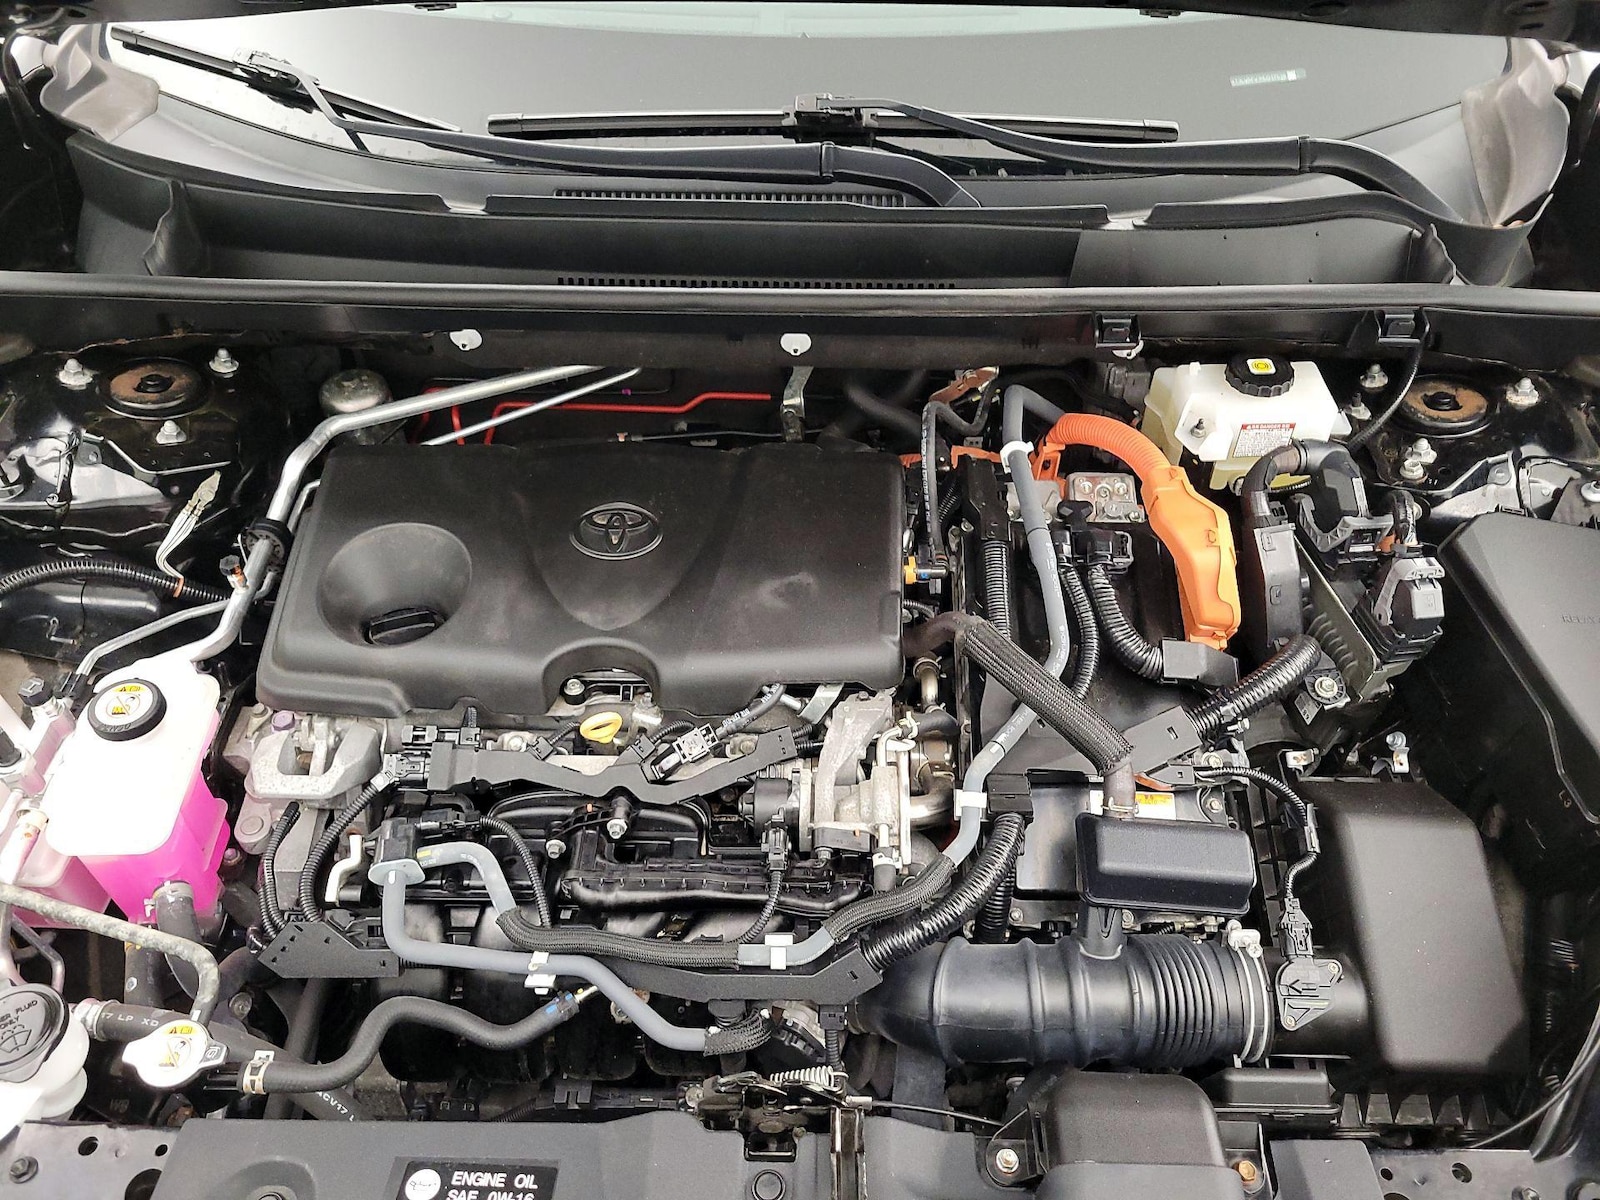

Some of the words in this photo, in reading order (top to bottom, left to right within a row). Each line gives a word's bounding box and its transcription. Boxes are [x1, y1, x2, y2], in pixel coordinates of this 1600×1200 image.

[15, 1000, 38, 1014] FLUID
[117, 1013, 134, 1022] LP
[141, 1017, 160, 1027] XD
[451, 1170, 507, 1188] ENGINE
[514, 1173, 538, 1190] OIL
[446, 1189, 479, 1200] SAE
